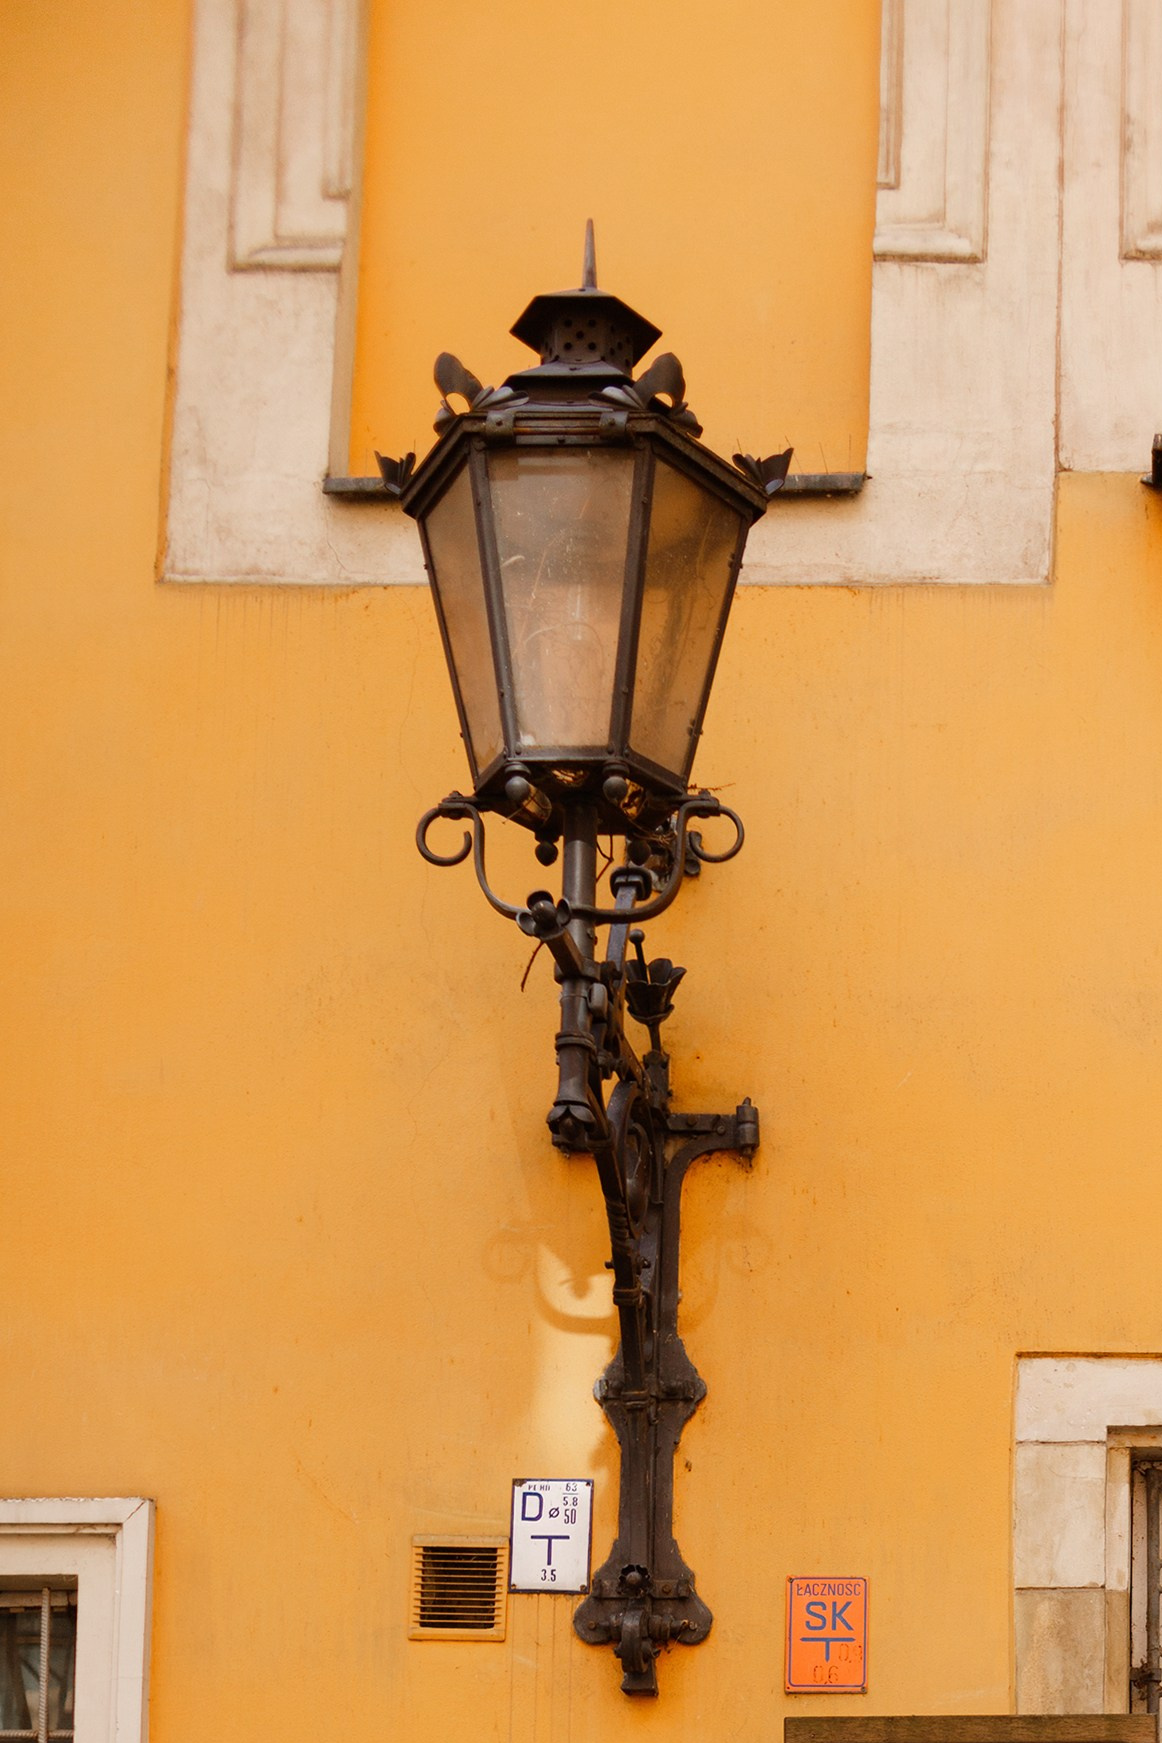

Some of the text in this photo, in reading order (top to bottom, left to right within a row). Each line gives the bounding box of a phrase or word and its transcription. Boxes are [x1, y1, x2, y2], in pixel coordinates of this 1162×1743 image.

[565, 1482, 578, 1492] 63
[521, 1491, 544, 1521] D
[564, 1508, 577, 1525] 50
[562, 1496, 578, 1507] 5.8
[540, 1568, 557, 1582] 3.5
[805, 1601, 854, 1631] SK
